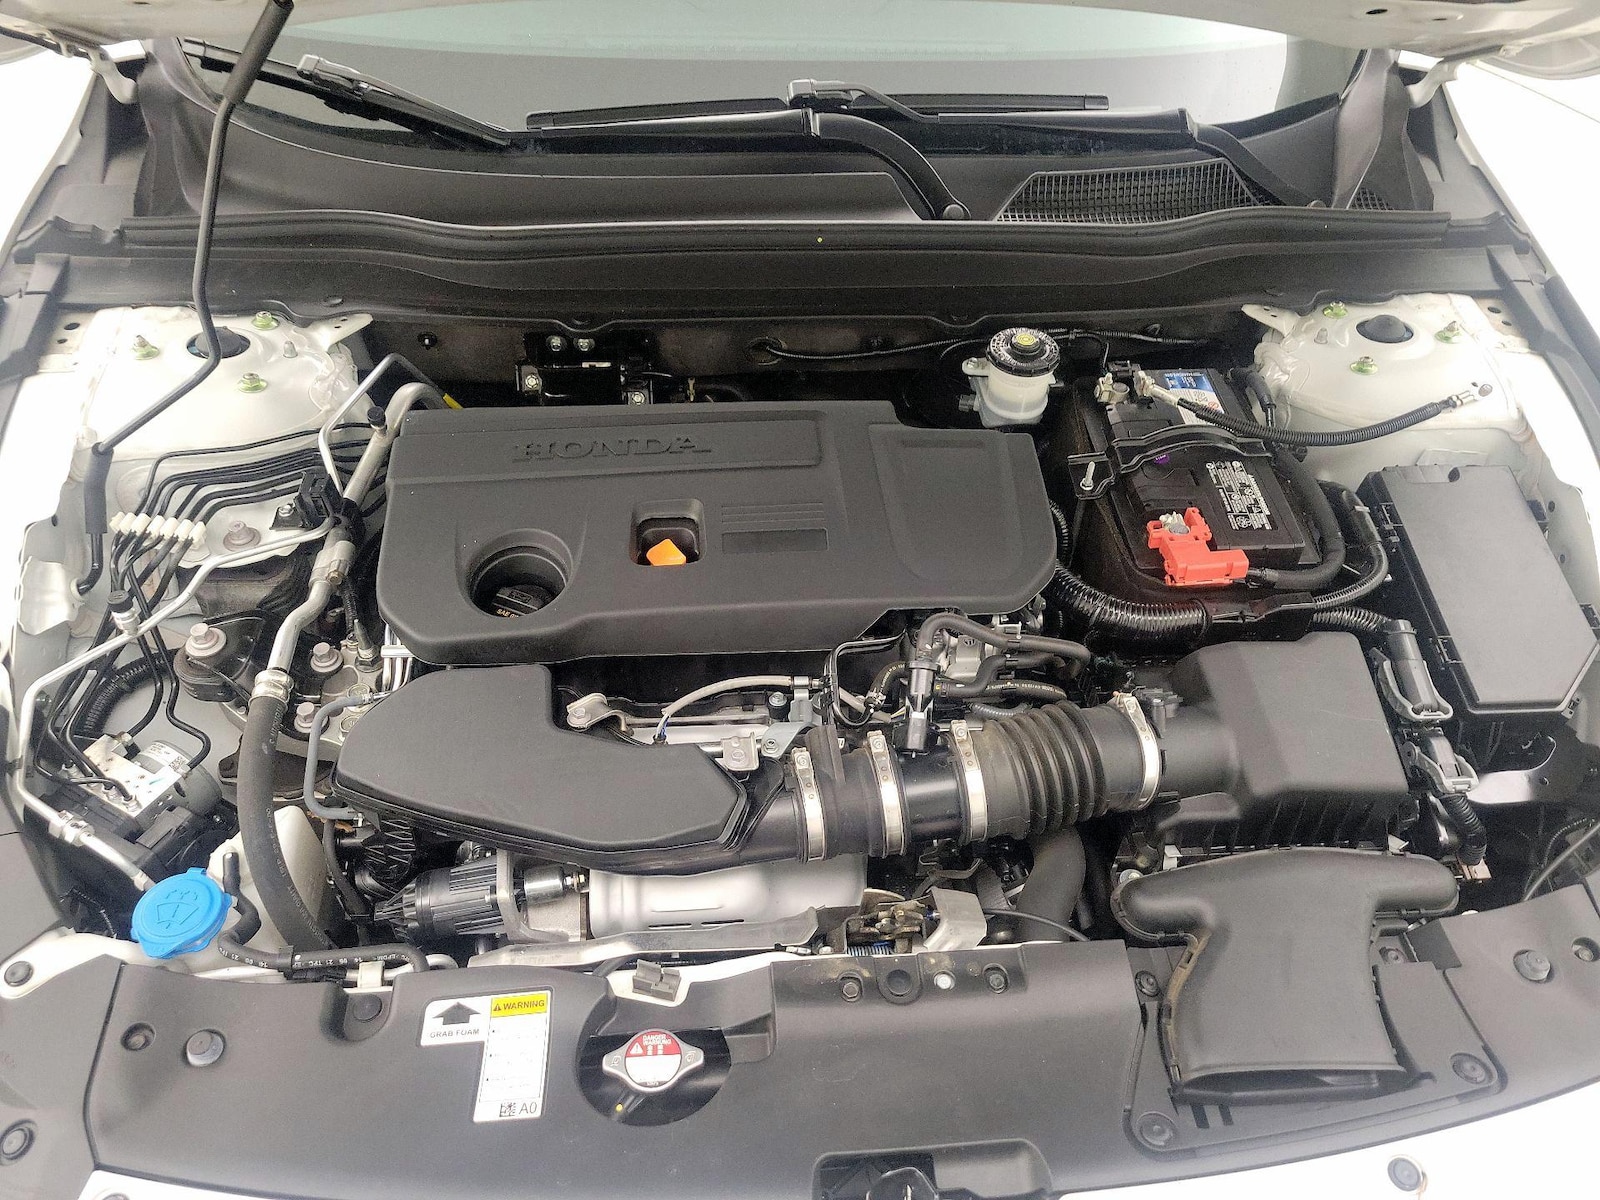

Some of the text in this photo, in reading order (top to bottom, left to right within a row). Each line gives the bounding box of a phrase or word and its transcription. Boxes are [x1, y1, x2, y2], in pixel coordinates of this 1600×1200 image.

[512, 438, 712, 462] HONDA
[503, 999, 545, 1011] WARNING
[430, 1028, 480, 1039] GRAB FOAM
